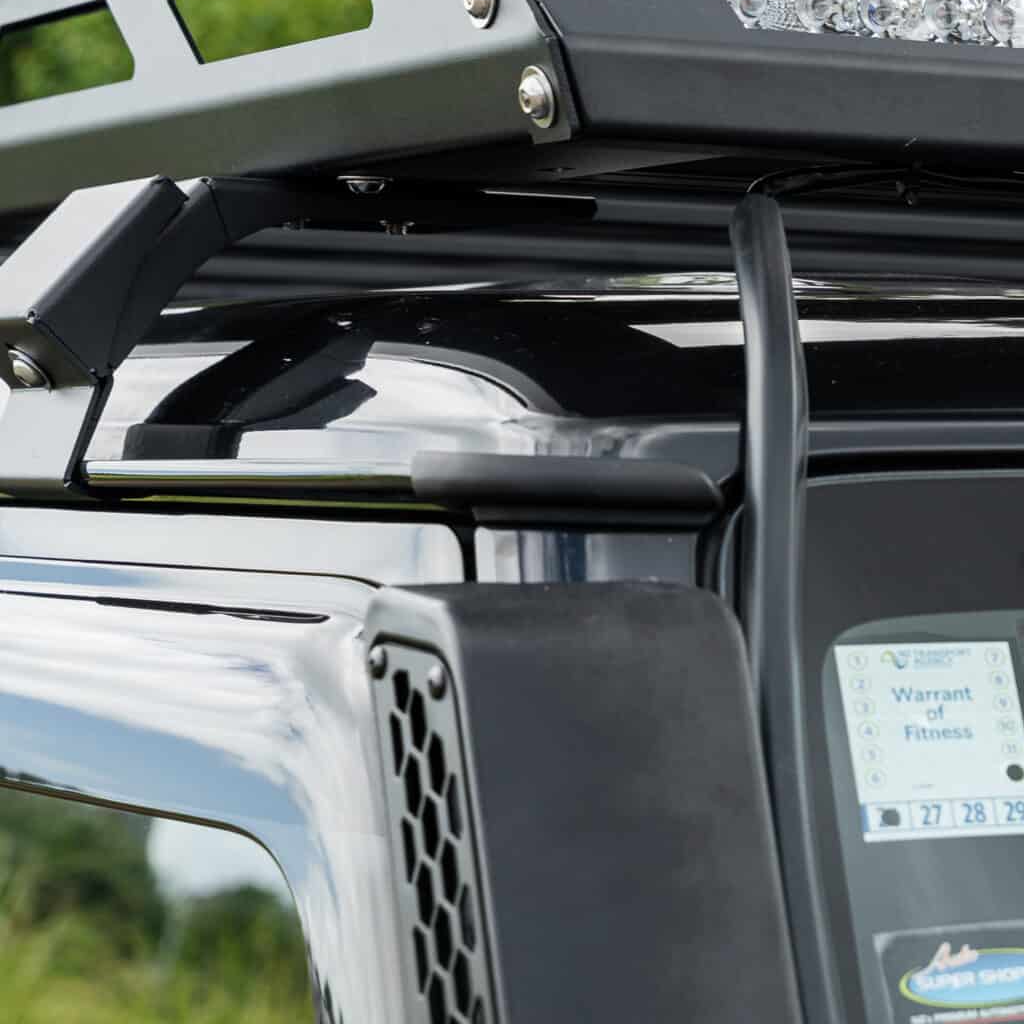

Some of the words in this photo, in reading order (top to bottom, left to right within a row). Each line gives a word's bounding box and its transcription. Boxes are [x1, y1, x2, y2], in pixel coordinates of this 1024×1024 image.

[892, 687, 973, 703] Warrant
[926, 705, 944, 721] of
[904, 726, 974, 742] Fitness
[920, 804, 942, 825] 27
[962, 802, 987, 823] 28
